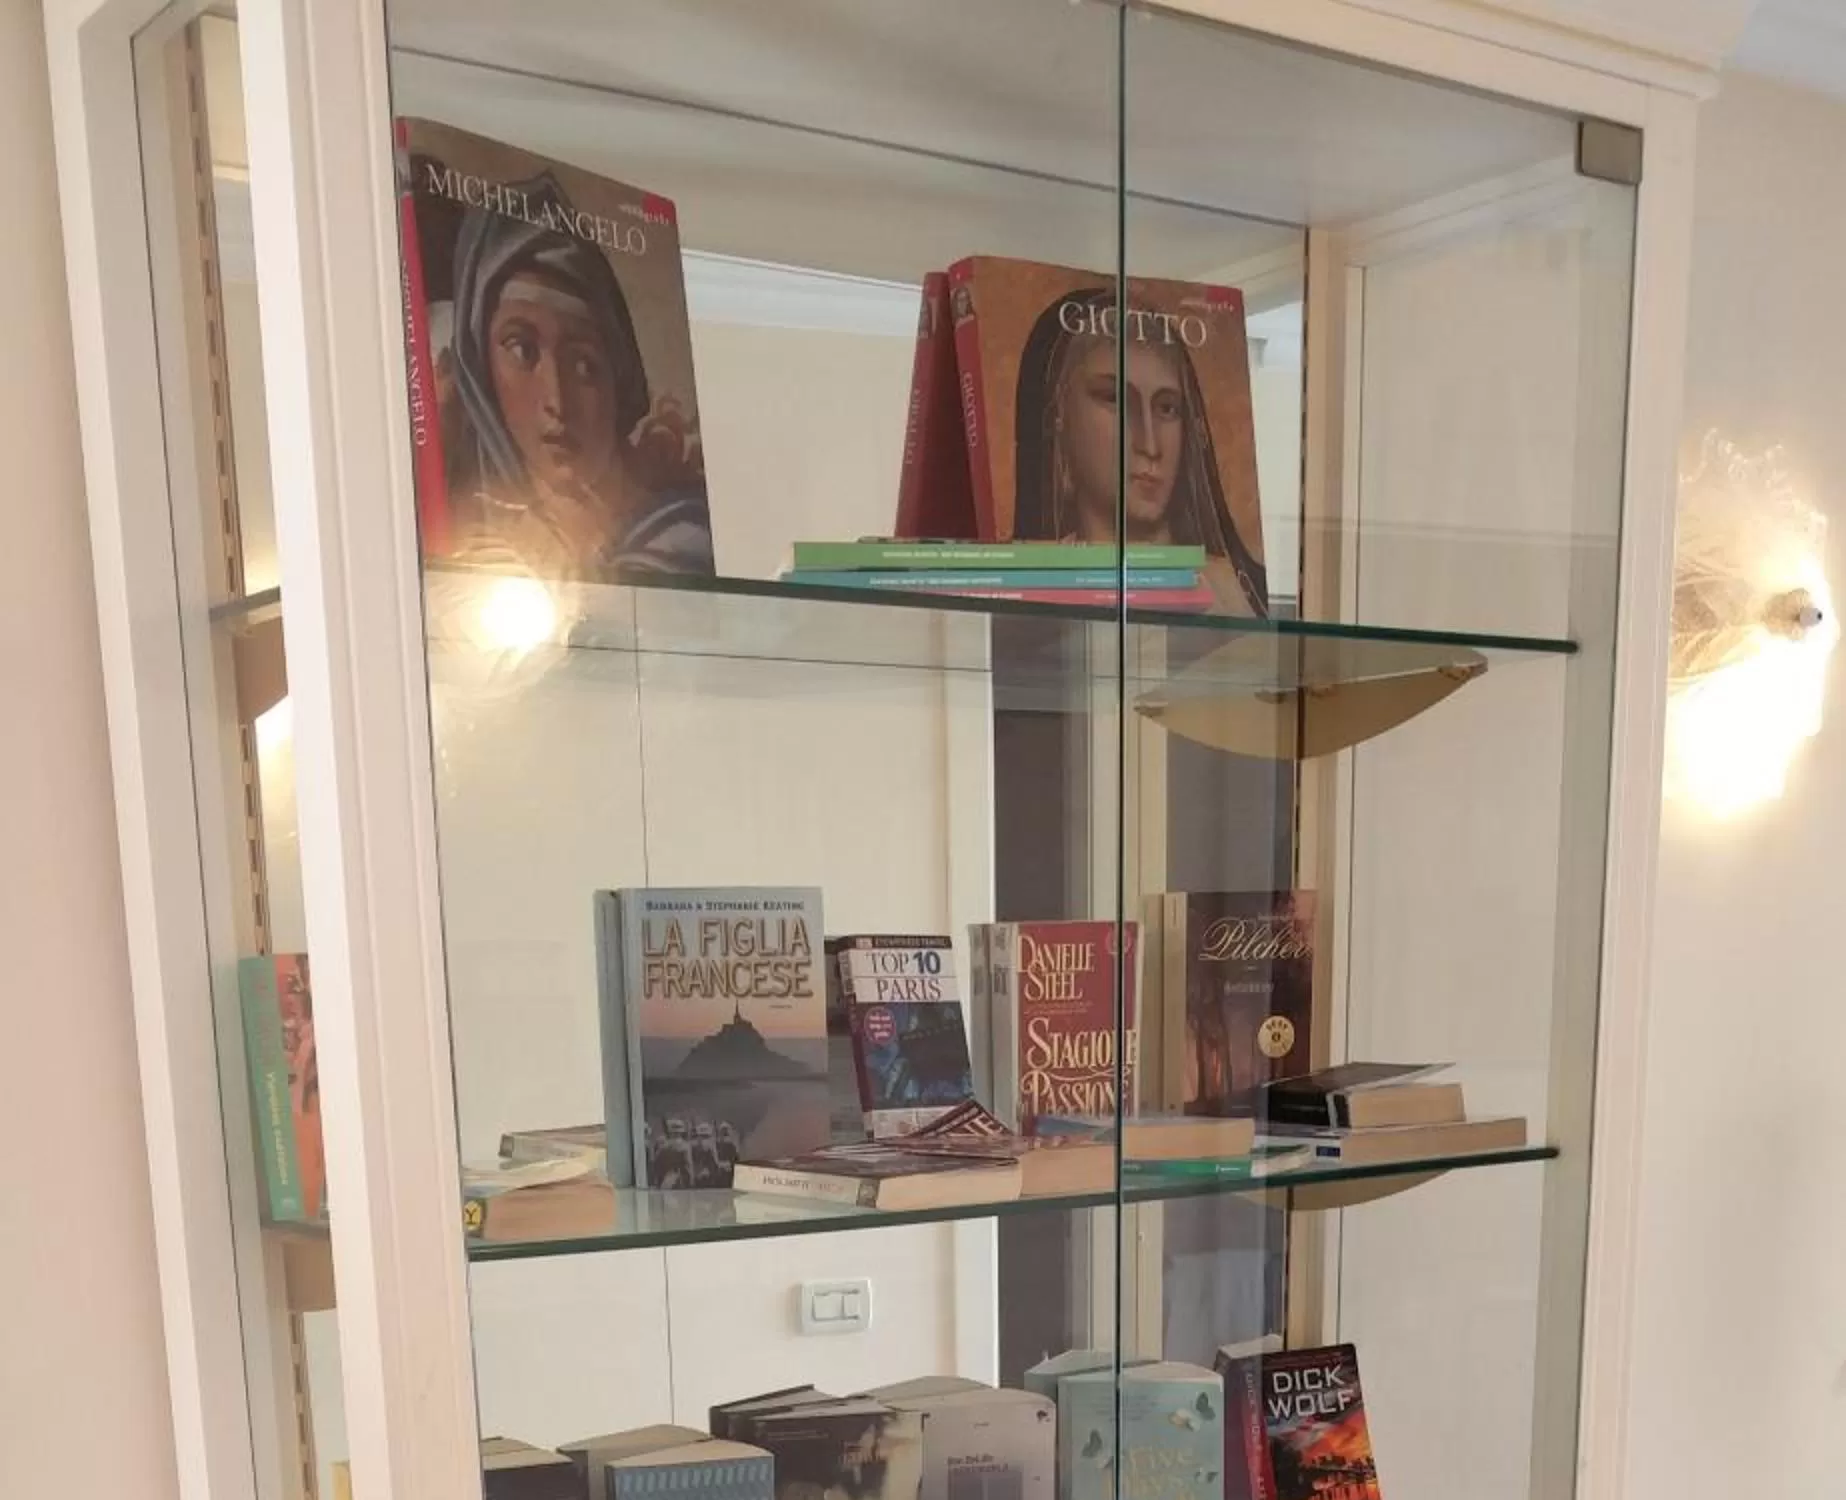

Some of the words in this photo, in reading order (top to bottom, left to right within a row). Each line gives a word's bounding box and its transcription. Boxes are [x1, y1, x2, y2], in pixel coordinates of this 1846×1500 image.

[426, 163, 648, 256] MICHELANGELO
[1058, 300, 1207, 349] GIOTTO
[641, 916, 687, 957] LA
[699, 914, 812, 957] FIGLIA
[1016, 934, 1095, 973] DANIELLE
[642, 959, 814, 999] FRANCESE
[864, 951, 909, 974] TOP
[912, 950, 942, 975] 10
[1024, 960, 1084, 1001] STEEL
[876, 978, 943, 1001] PARIS
[1027, 1016, 1137, 1070] STAGIOE
[1272, 1364, 1346, 1394] DICK
[1267, 1388, 1354, 1419] WOLF
